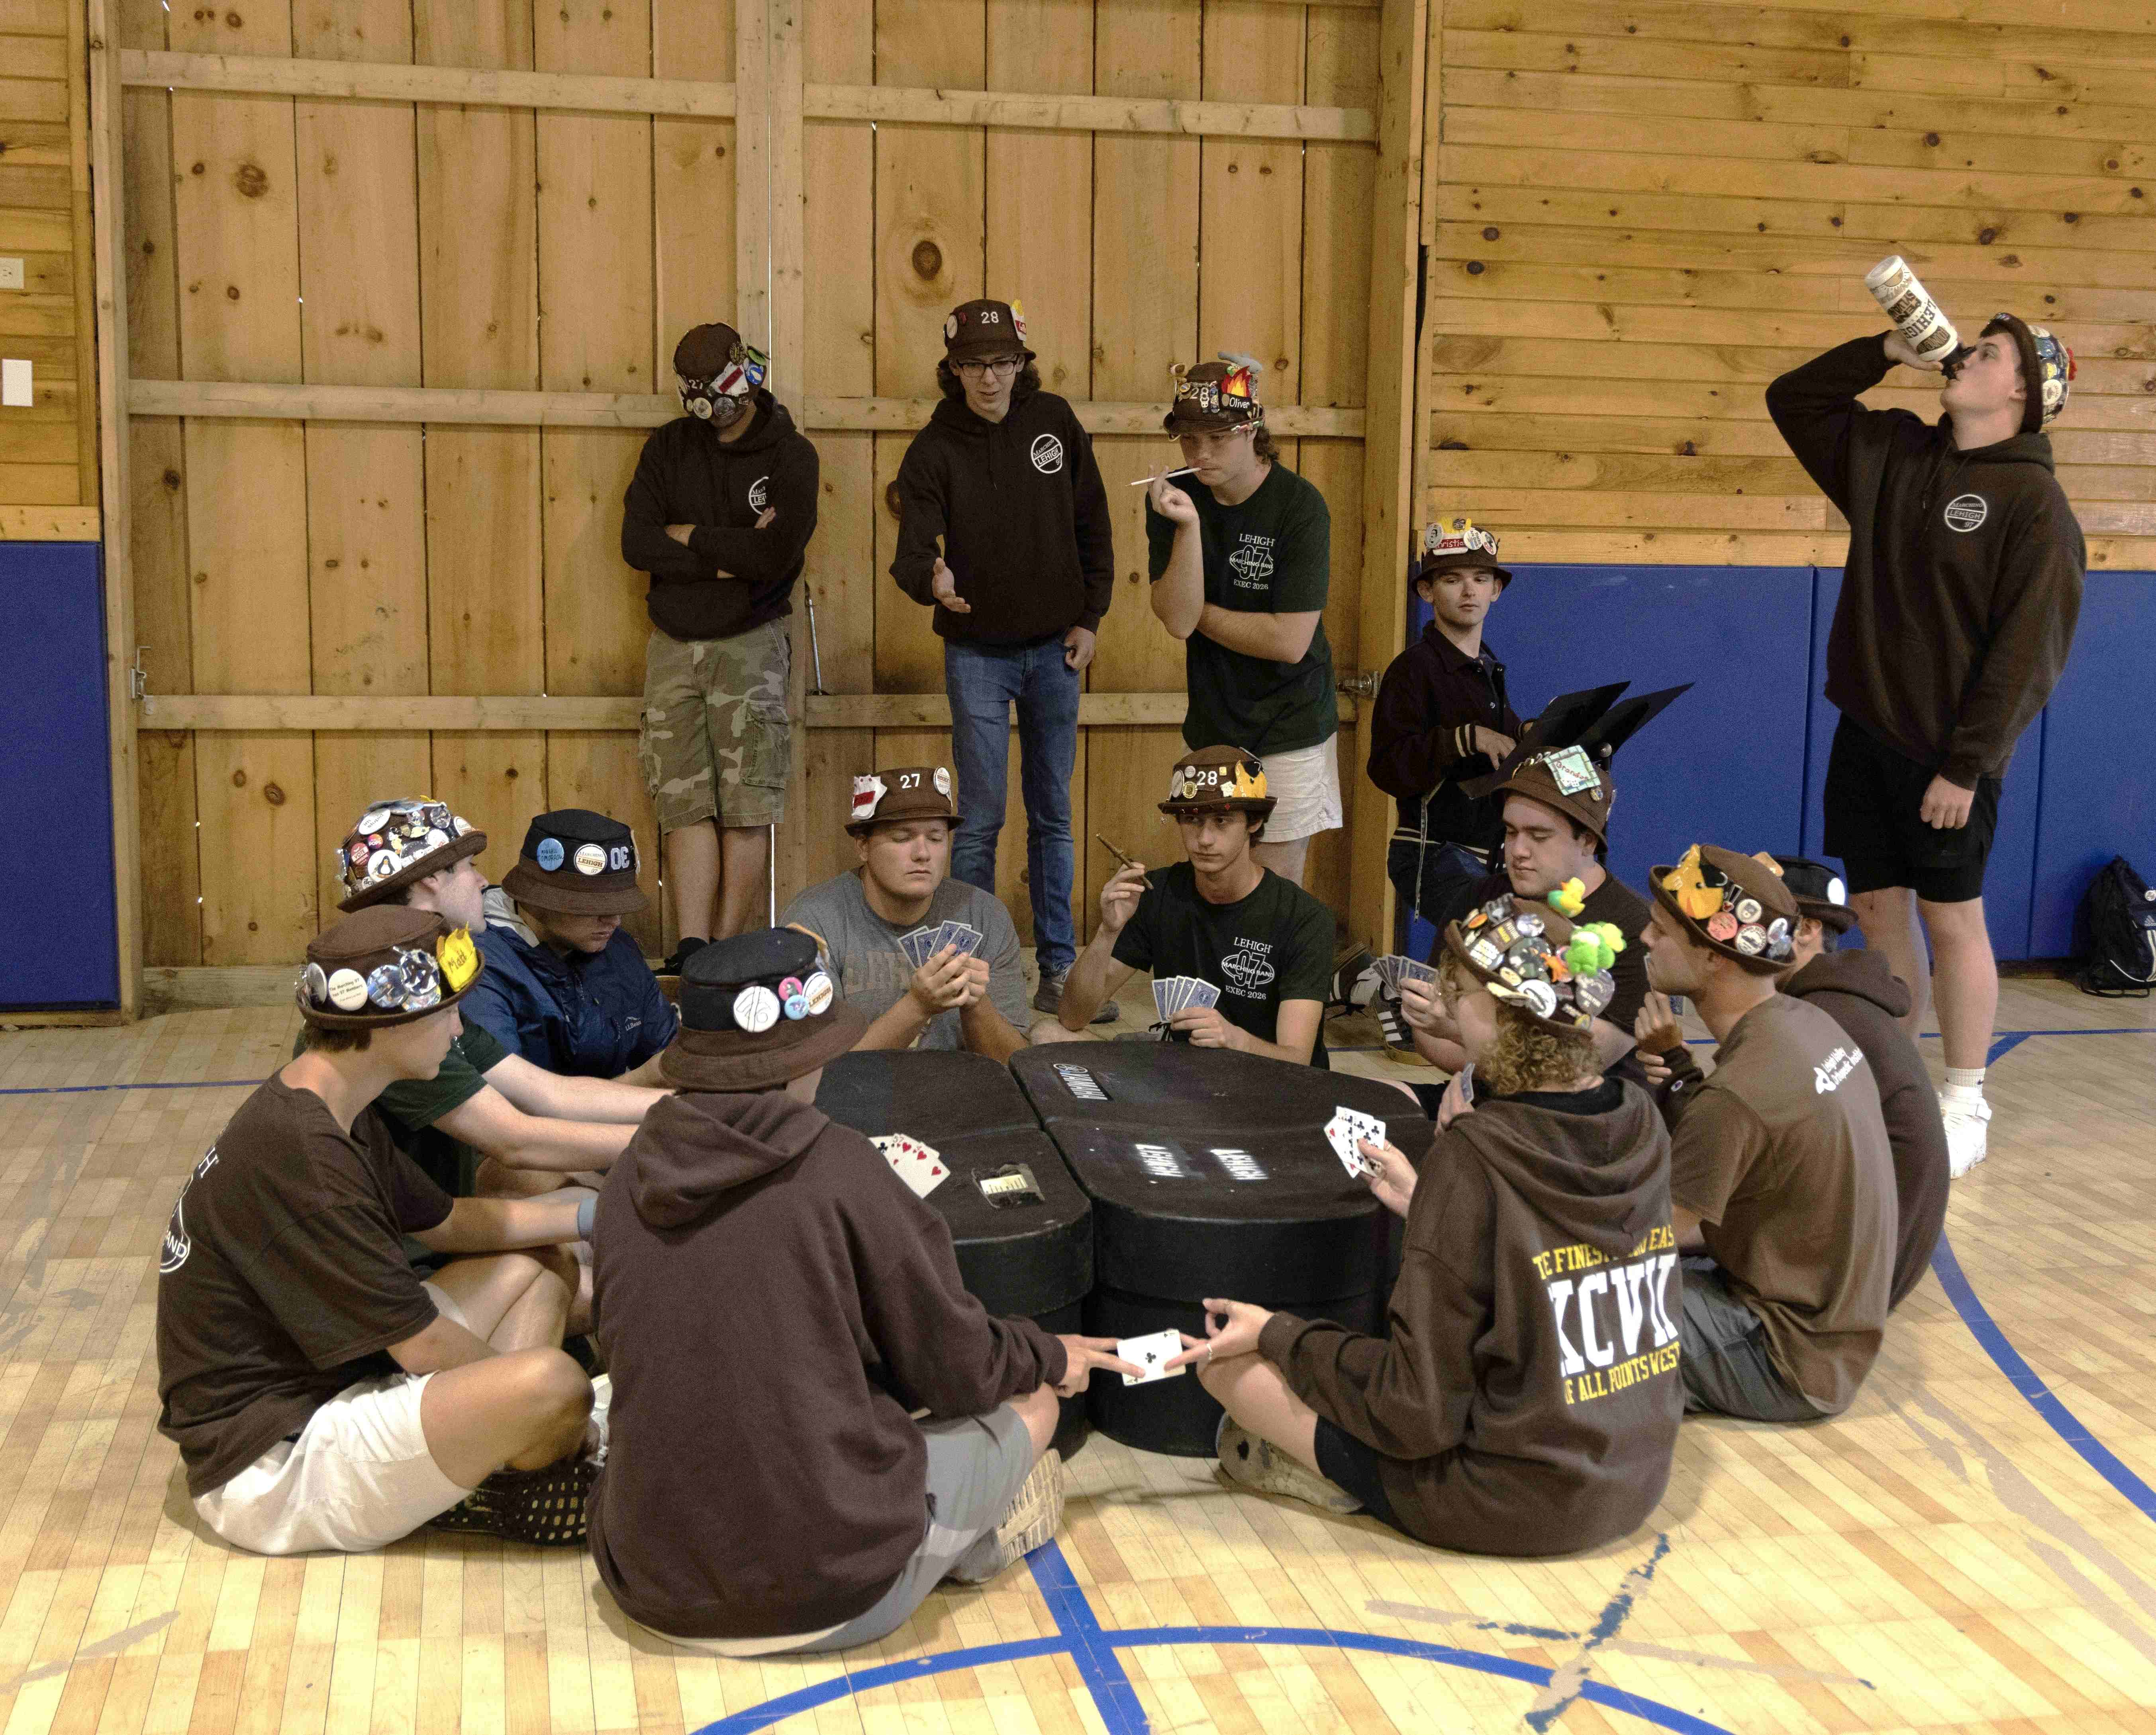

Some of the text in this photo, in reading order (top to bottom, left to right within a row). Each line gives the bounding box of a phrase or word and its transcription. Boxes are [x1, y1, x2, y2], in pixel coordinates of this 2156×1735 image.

[981, 311, 999, 324] 28
[1190, 387, 1210, 402] 28
[1229, 397, 1250, 408] Oliver
[1037, 448, 1059, 465] LEHIGH
[1950, 510, 1981, 520] LEHIGH
[1239, 533, 1276, 547] LEHIGH
[1230, 557, 1260, 567] MARCHING
[1239, 544, 1270, 581] 97
[1233, 579, 1251, 588] EXEC
[900, 773, 921, 789] 27
[1197, 770, 1218, 786] 28
[353, 849, 365, 859] VOTE
[577, 858, 603, 868] LEHIGH
[1233, 937, 1271, 954] LEHIGH
[1222, 962, 1255, 974] MARCHING
[1234, 949, 1266, 989] 97
[1225, 985, 1267, 1000] EXEC 2026
[1553, 1243, 1610, 1273] FINES
[1578, 1372, 1608, 1402] ALL
[1607, 1355, 1650, 1393] POINTS
[1648, 1341, 1680, 1375] WEST
